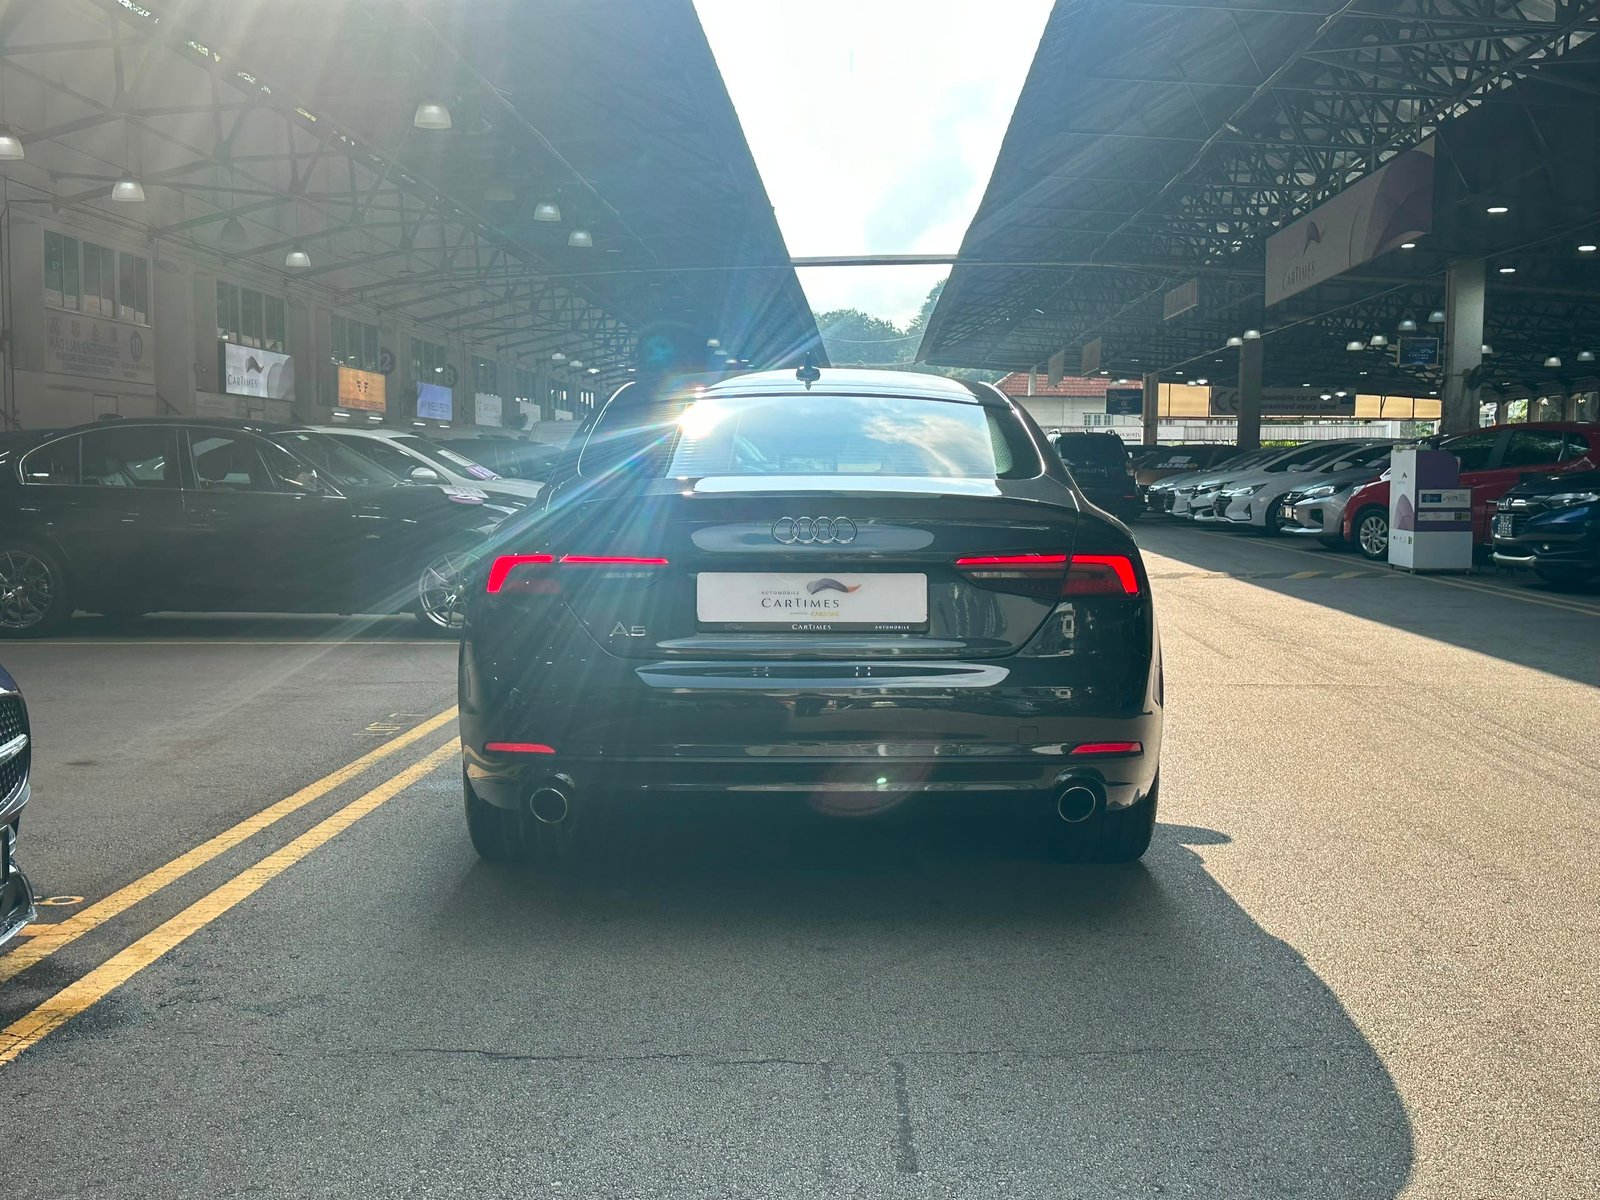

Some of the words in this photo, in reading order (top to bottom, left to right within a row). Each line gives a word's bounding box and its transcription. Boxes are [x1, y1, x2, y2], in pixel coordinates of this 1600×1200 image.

[382, 354, 392, 371] 2
[761, 598, 840, 608] CARTIMES
[609, 621, 646, 637] A5
